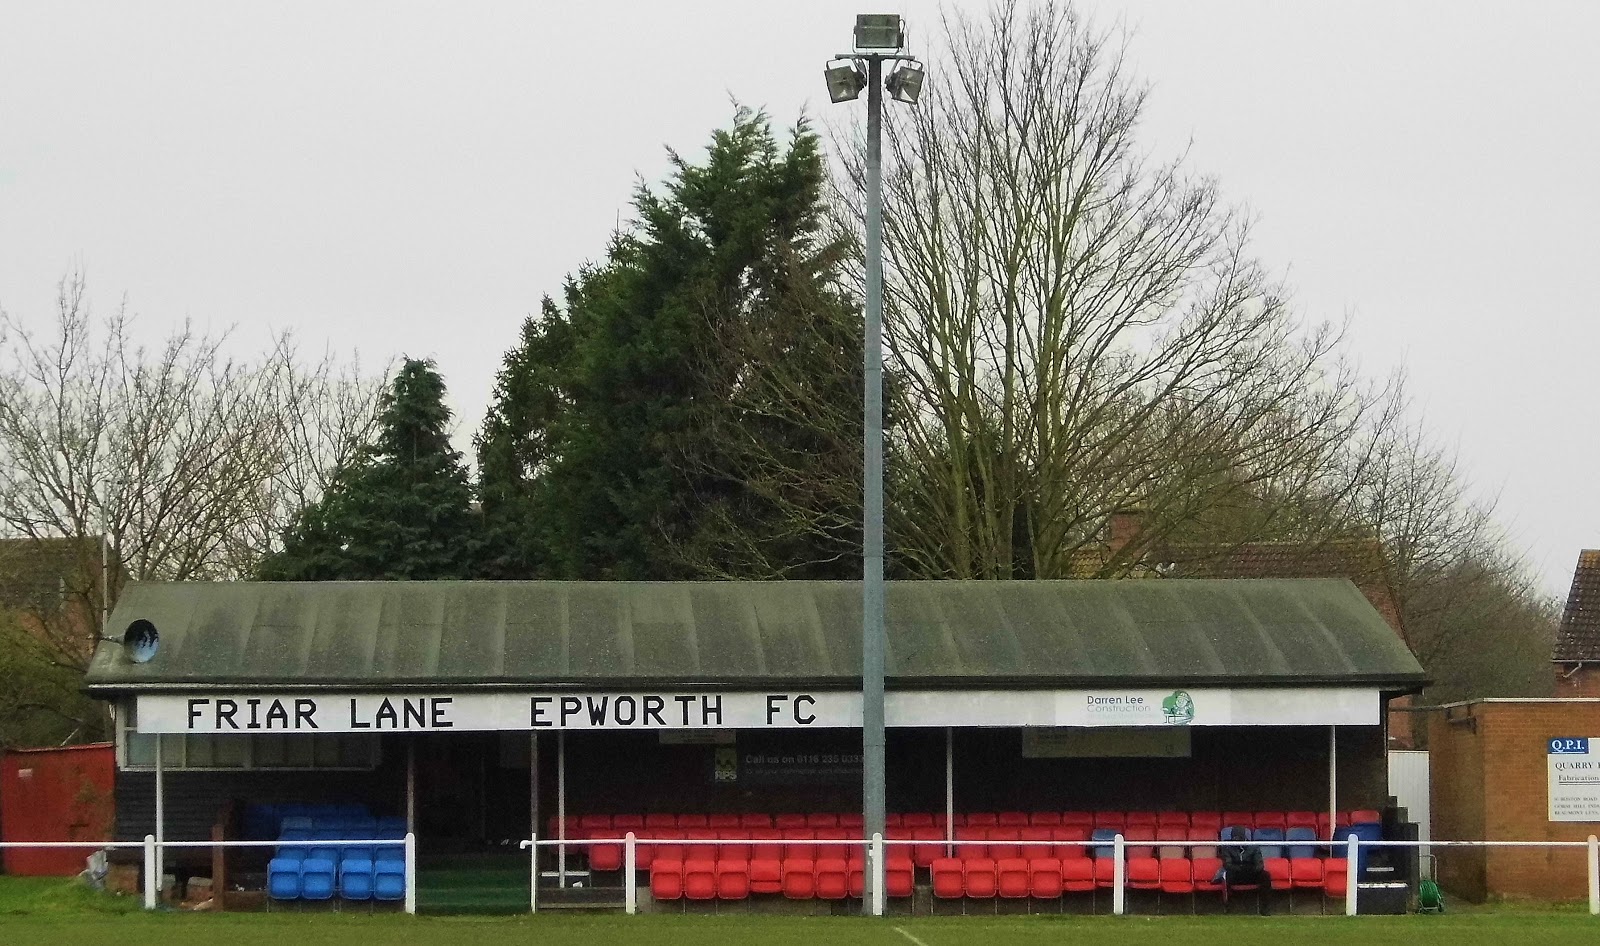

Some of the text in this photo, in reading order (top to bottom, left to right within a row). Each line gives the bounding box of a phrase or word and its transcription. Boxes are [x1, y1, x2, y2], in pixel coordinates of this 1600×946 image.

[1087, 695, 1144, 704] Darren Lee
[187, 694, 817, 730] FRIAR LANE EPWORTH FC
[1086, 704, 1151, 712] Construction
[1551, 739, 1585, 752] Q.P.I.
[745, 754, 765, 763] Call
[796, 754, 819, 763] 0116
[822, 754, 839, 763] 235
[1555, 762, 1593, 771] QUARRY
